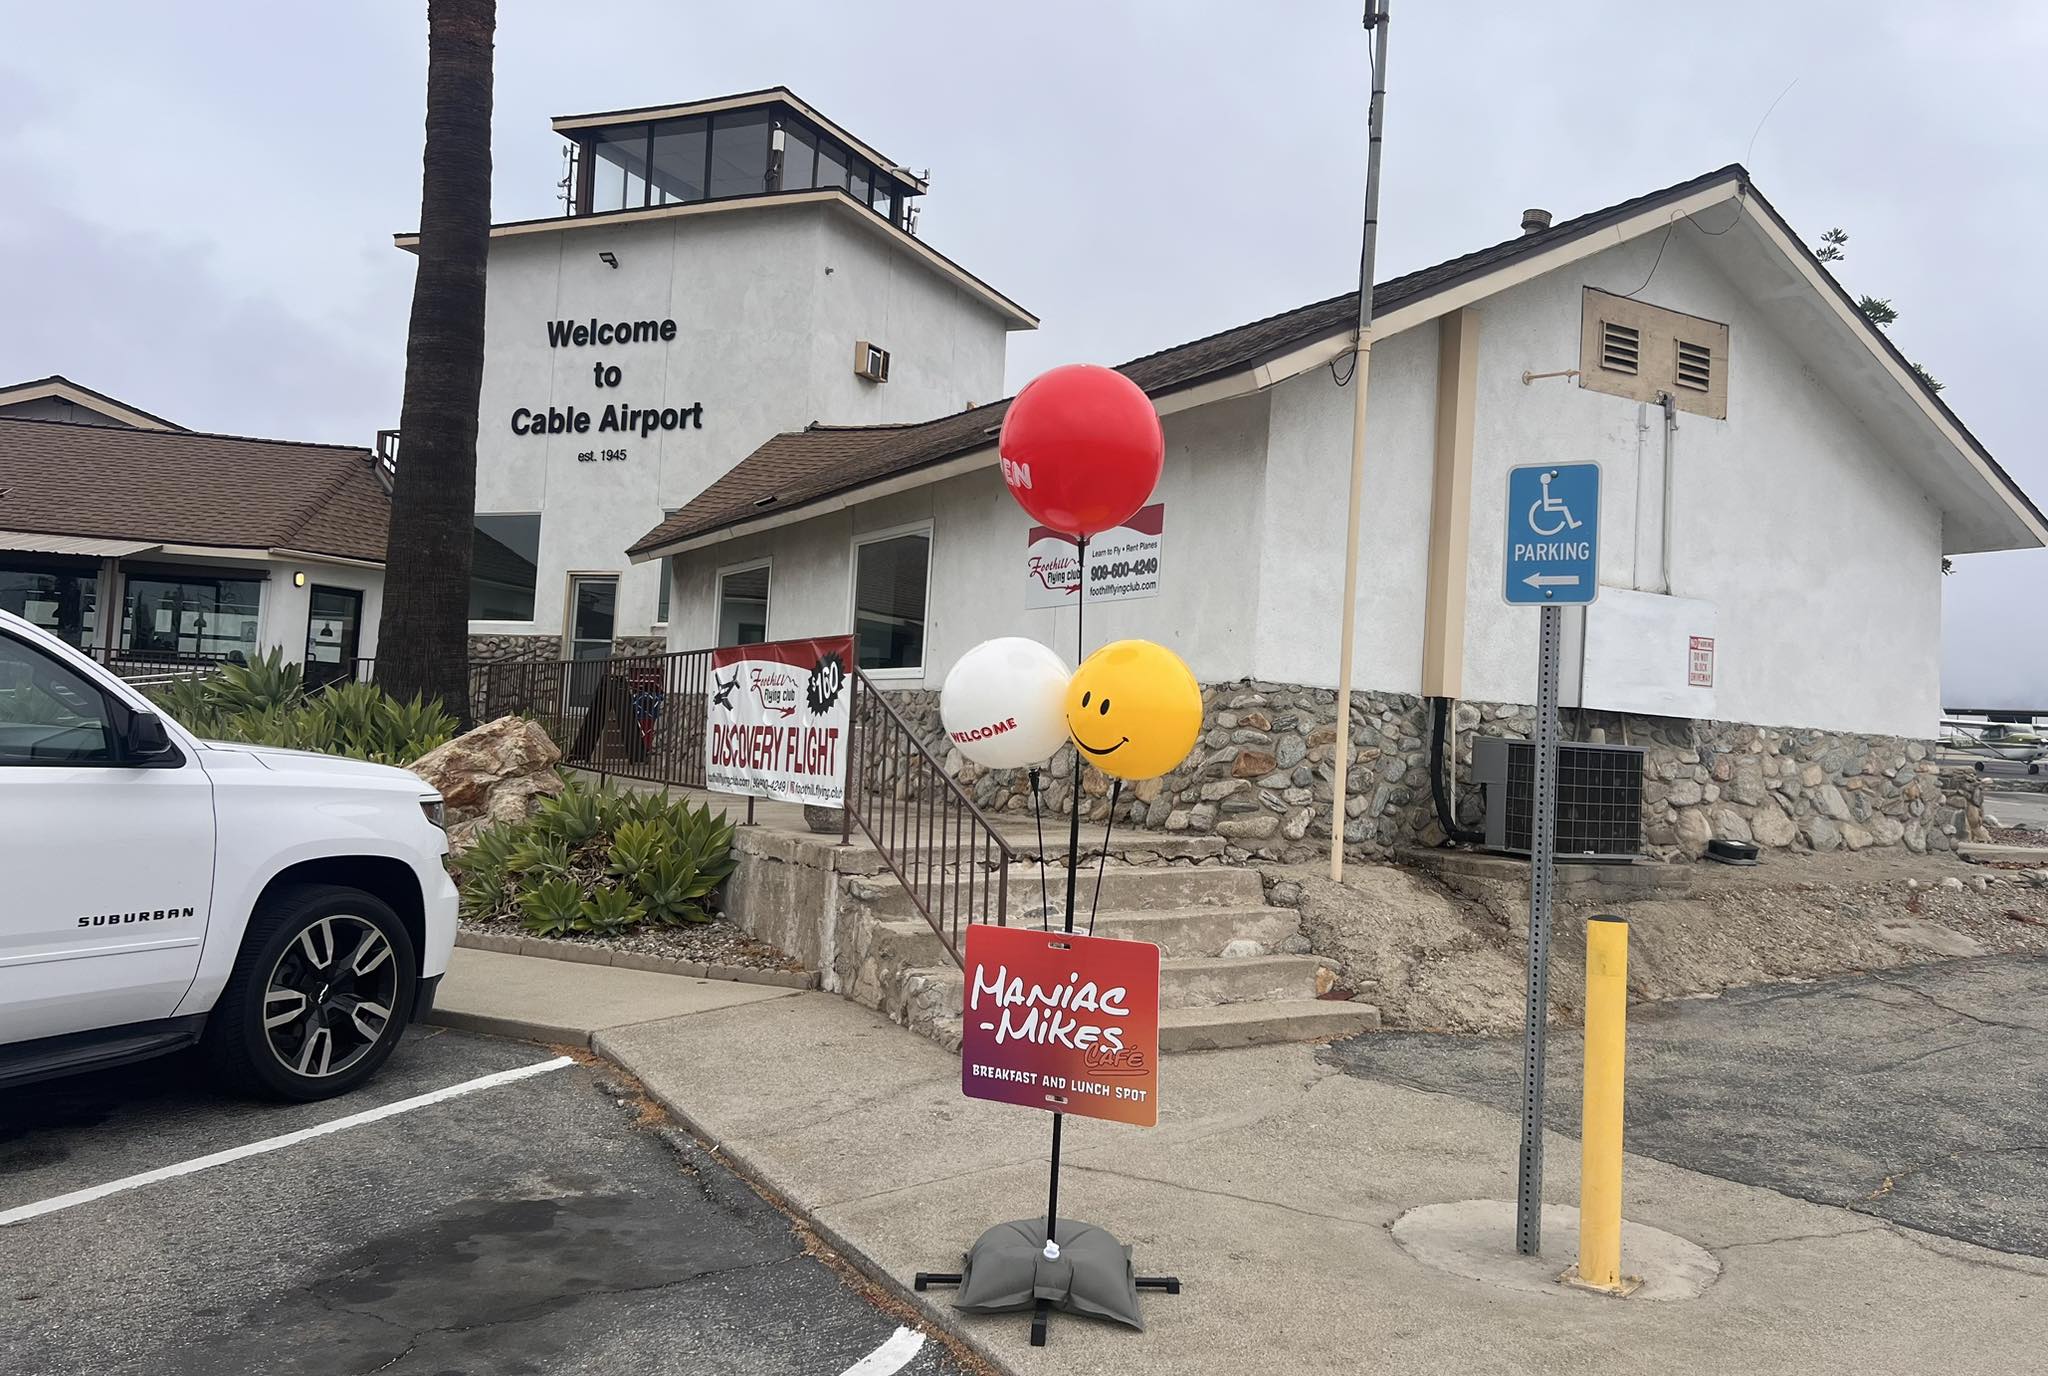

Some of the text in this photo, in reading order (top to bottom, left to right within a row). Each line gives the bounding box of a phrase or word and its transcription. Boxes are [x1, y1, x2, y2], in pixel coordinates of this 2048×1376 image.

[547, 318, 677, 348] Welcome
[593, 361, 622, 388] to
[511, 402, 703, 438] Cable Airport
[577, 449, 627, 462] est. 1945
[1092, 550, 1106, 558] Learn
[1126, 543, 1139, 552] Rent
[1139, 541, 1158, 551] Planes
[1514, 542, 1590, 562] PARKING
[1028, 556, 1070, 578] Foothill
[1047, 571, 1066, 585] Flying
[1090, 557, 1158, 582] 909-600-4249
[1089, 581, 1157, 597] foothillflyingclub.com
[812, 661, 839, 704] $160
[764, 688, 796, 703] Flying club
[950, 717, 1017, 743] WELCOME
[712, 723, 839, 776] DISCOVERY FLIGHT
[77, 907, 194, 928] SUBURBAN
[972, 1063, 1147, 1102] BREAKFAST AND LUNCH SPOT
